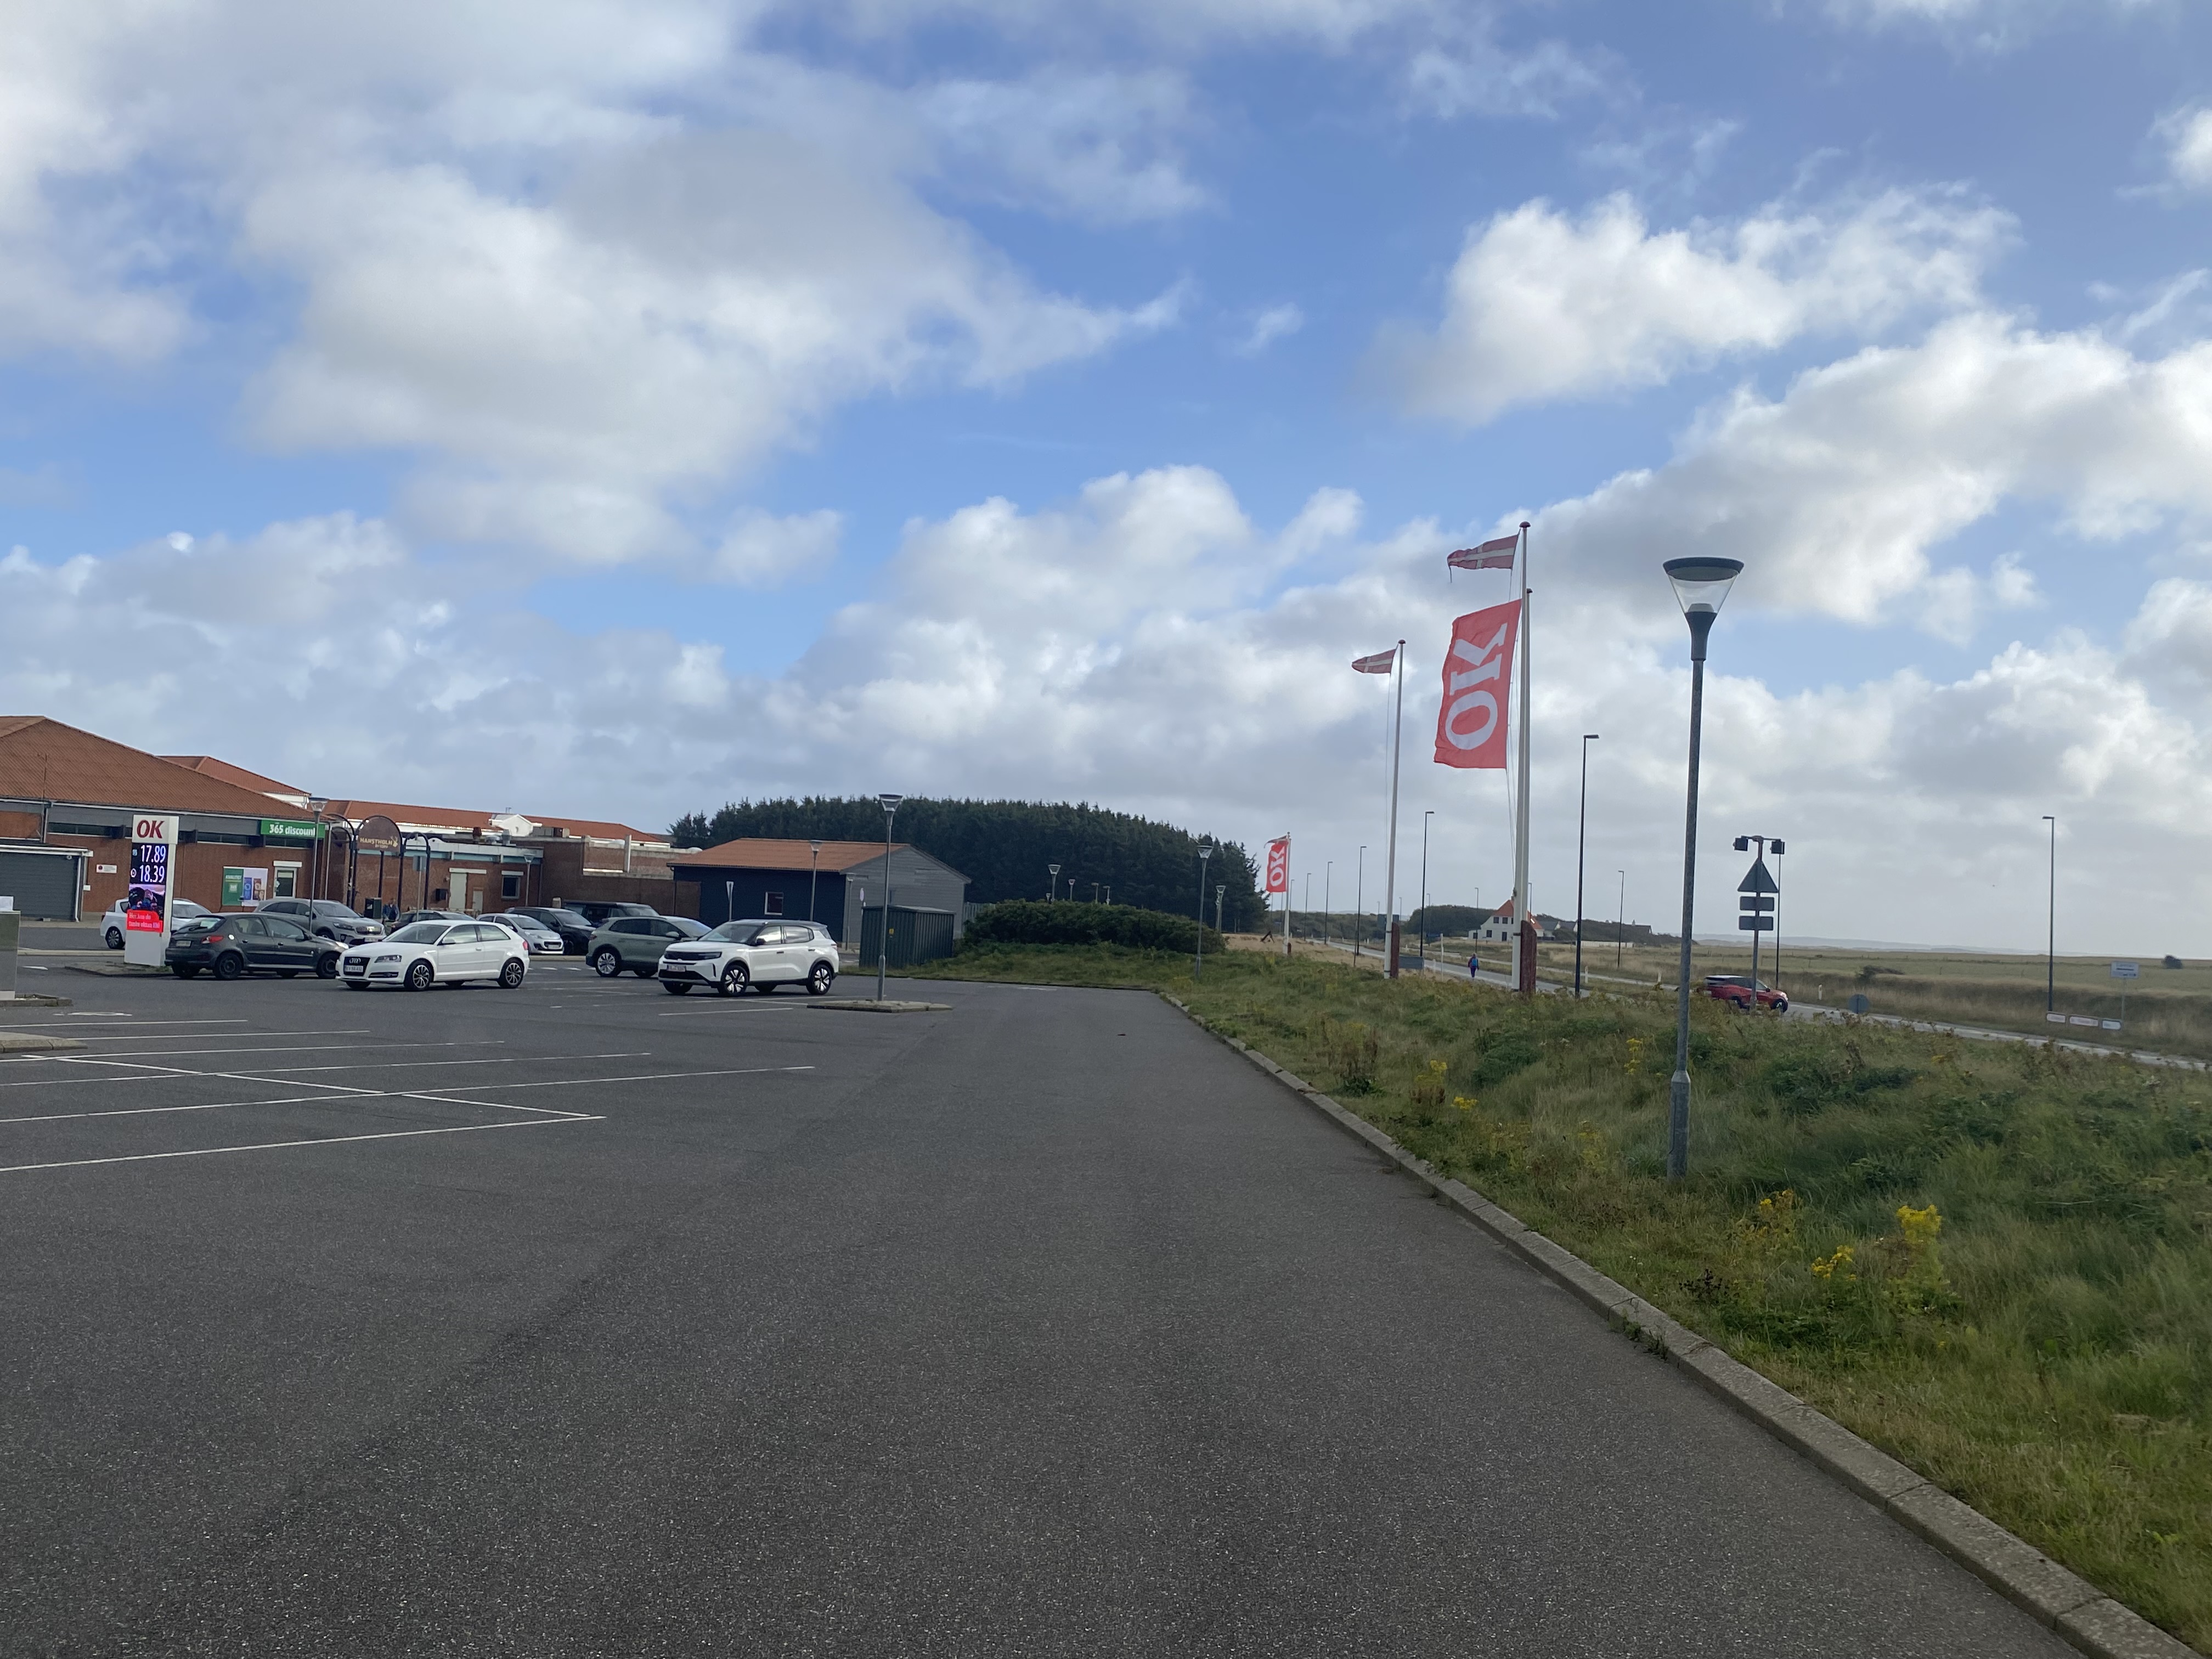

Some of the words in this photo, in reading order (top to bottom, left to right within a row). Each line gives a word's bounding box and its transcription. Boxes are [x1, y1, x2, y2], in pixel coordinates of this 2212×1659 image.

[137, 820, 165, 838] OK
[269, 824, 284, 834] 365
[285, 826, 315, 836] discount
[141, 845, 166, 863] 17.89
[139, 865, 165, 883] 18.39
